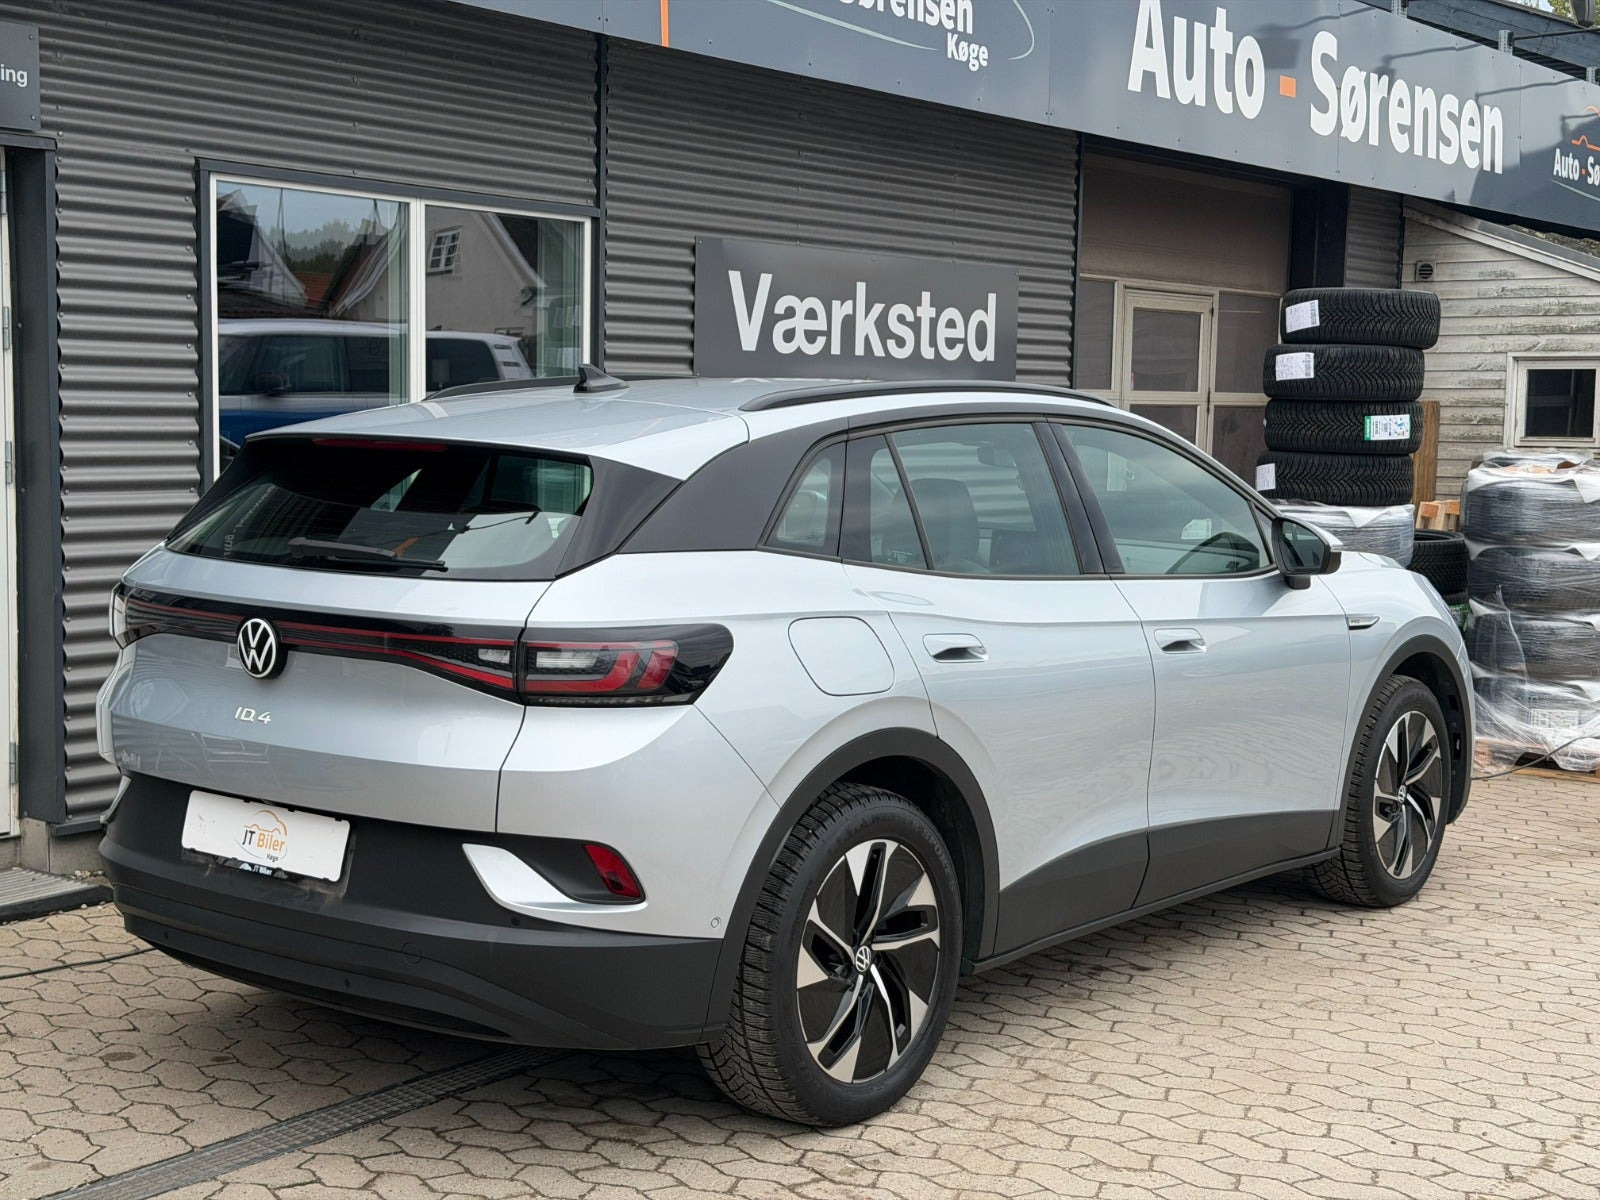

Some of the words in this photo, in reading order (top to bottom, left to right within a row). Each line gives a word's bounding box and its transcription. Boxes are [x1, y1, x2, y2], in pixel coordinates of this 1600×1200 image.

[947, 32, 989, 72] Køge
[0, 63, 28, 88] ing
[1128, 0, 1265, 119] Auto
[1310, 31, 1503, 174] Sørensen
[1553, 148, 1580, 181] Auto
[728, 270, 997, 362] Værksted
[242, 829, 256, 846] JT
[257, 832, 286, 852] Biler
